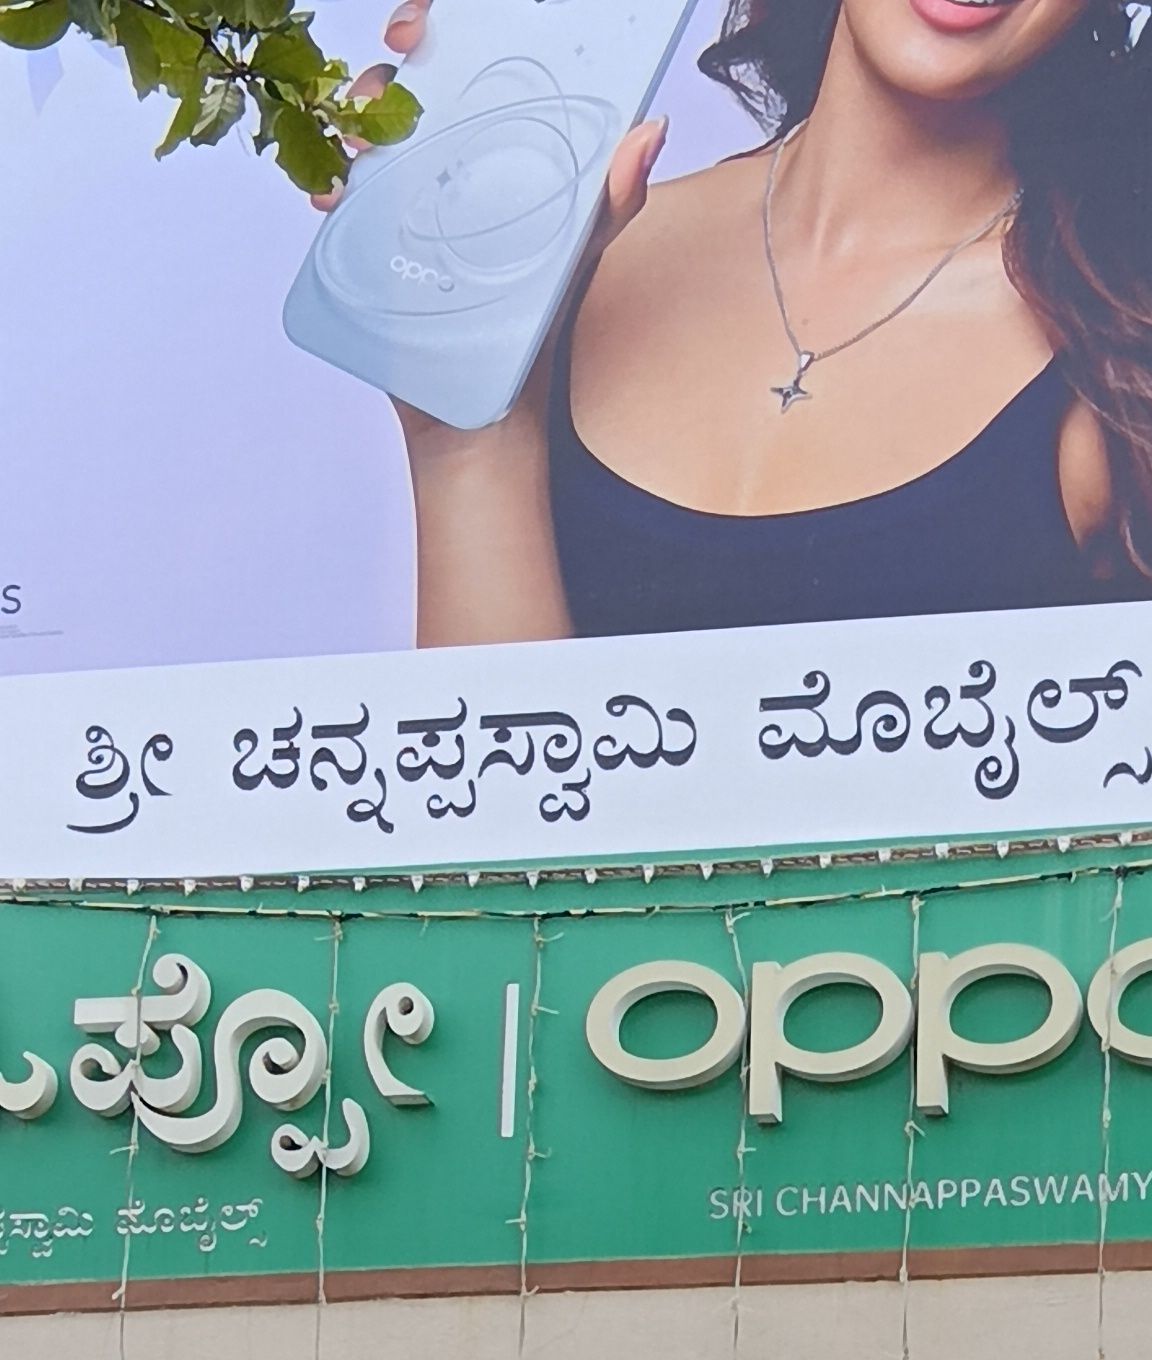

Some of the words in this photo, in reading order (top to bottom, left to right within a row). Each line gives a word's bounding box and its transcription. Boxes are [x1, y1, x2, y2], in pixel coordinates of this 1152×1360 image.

[67, 726, 173, 834] ಶ್ರೀ
[232, 695, 697, 834] ಚನ್ನಪ್ಪಸ್ವಾಮಿ
[116, 1197, 268, 1253] ಮೊಬೈಲ್ಸ್
[708, 1187, 763, 1221] SRI
